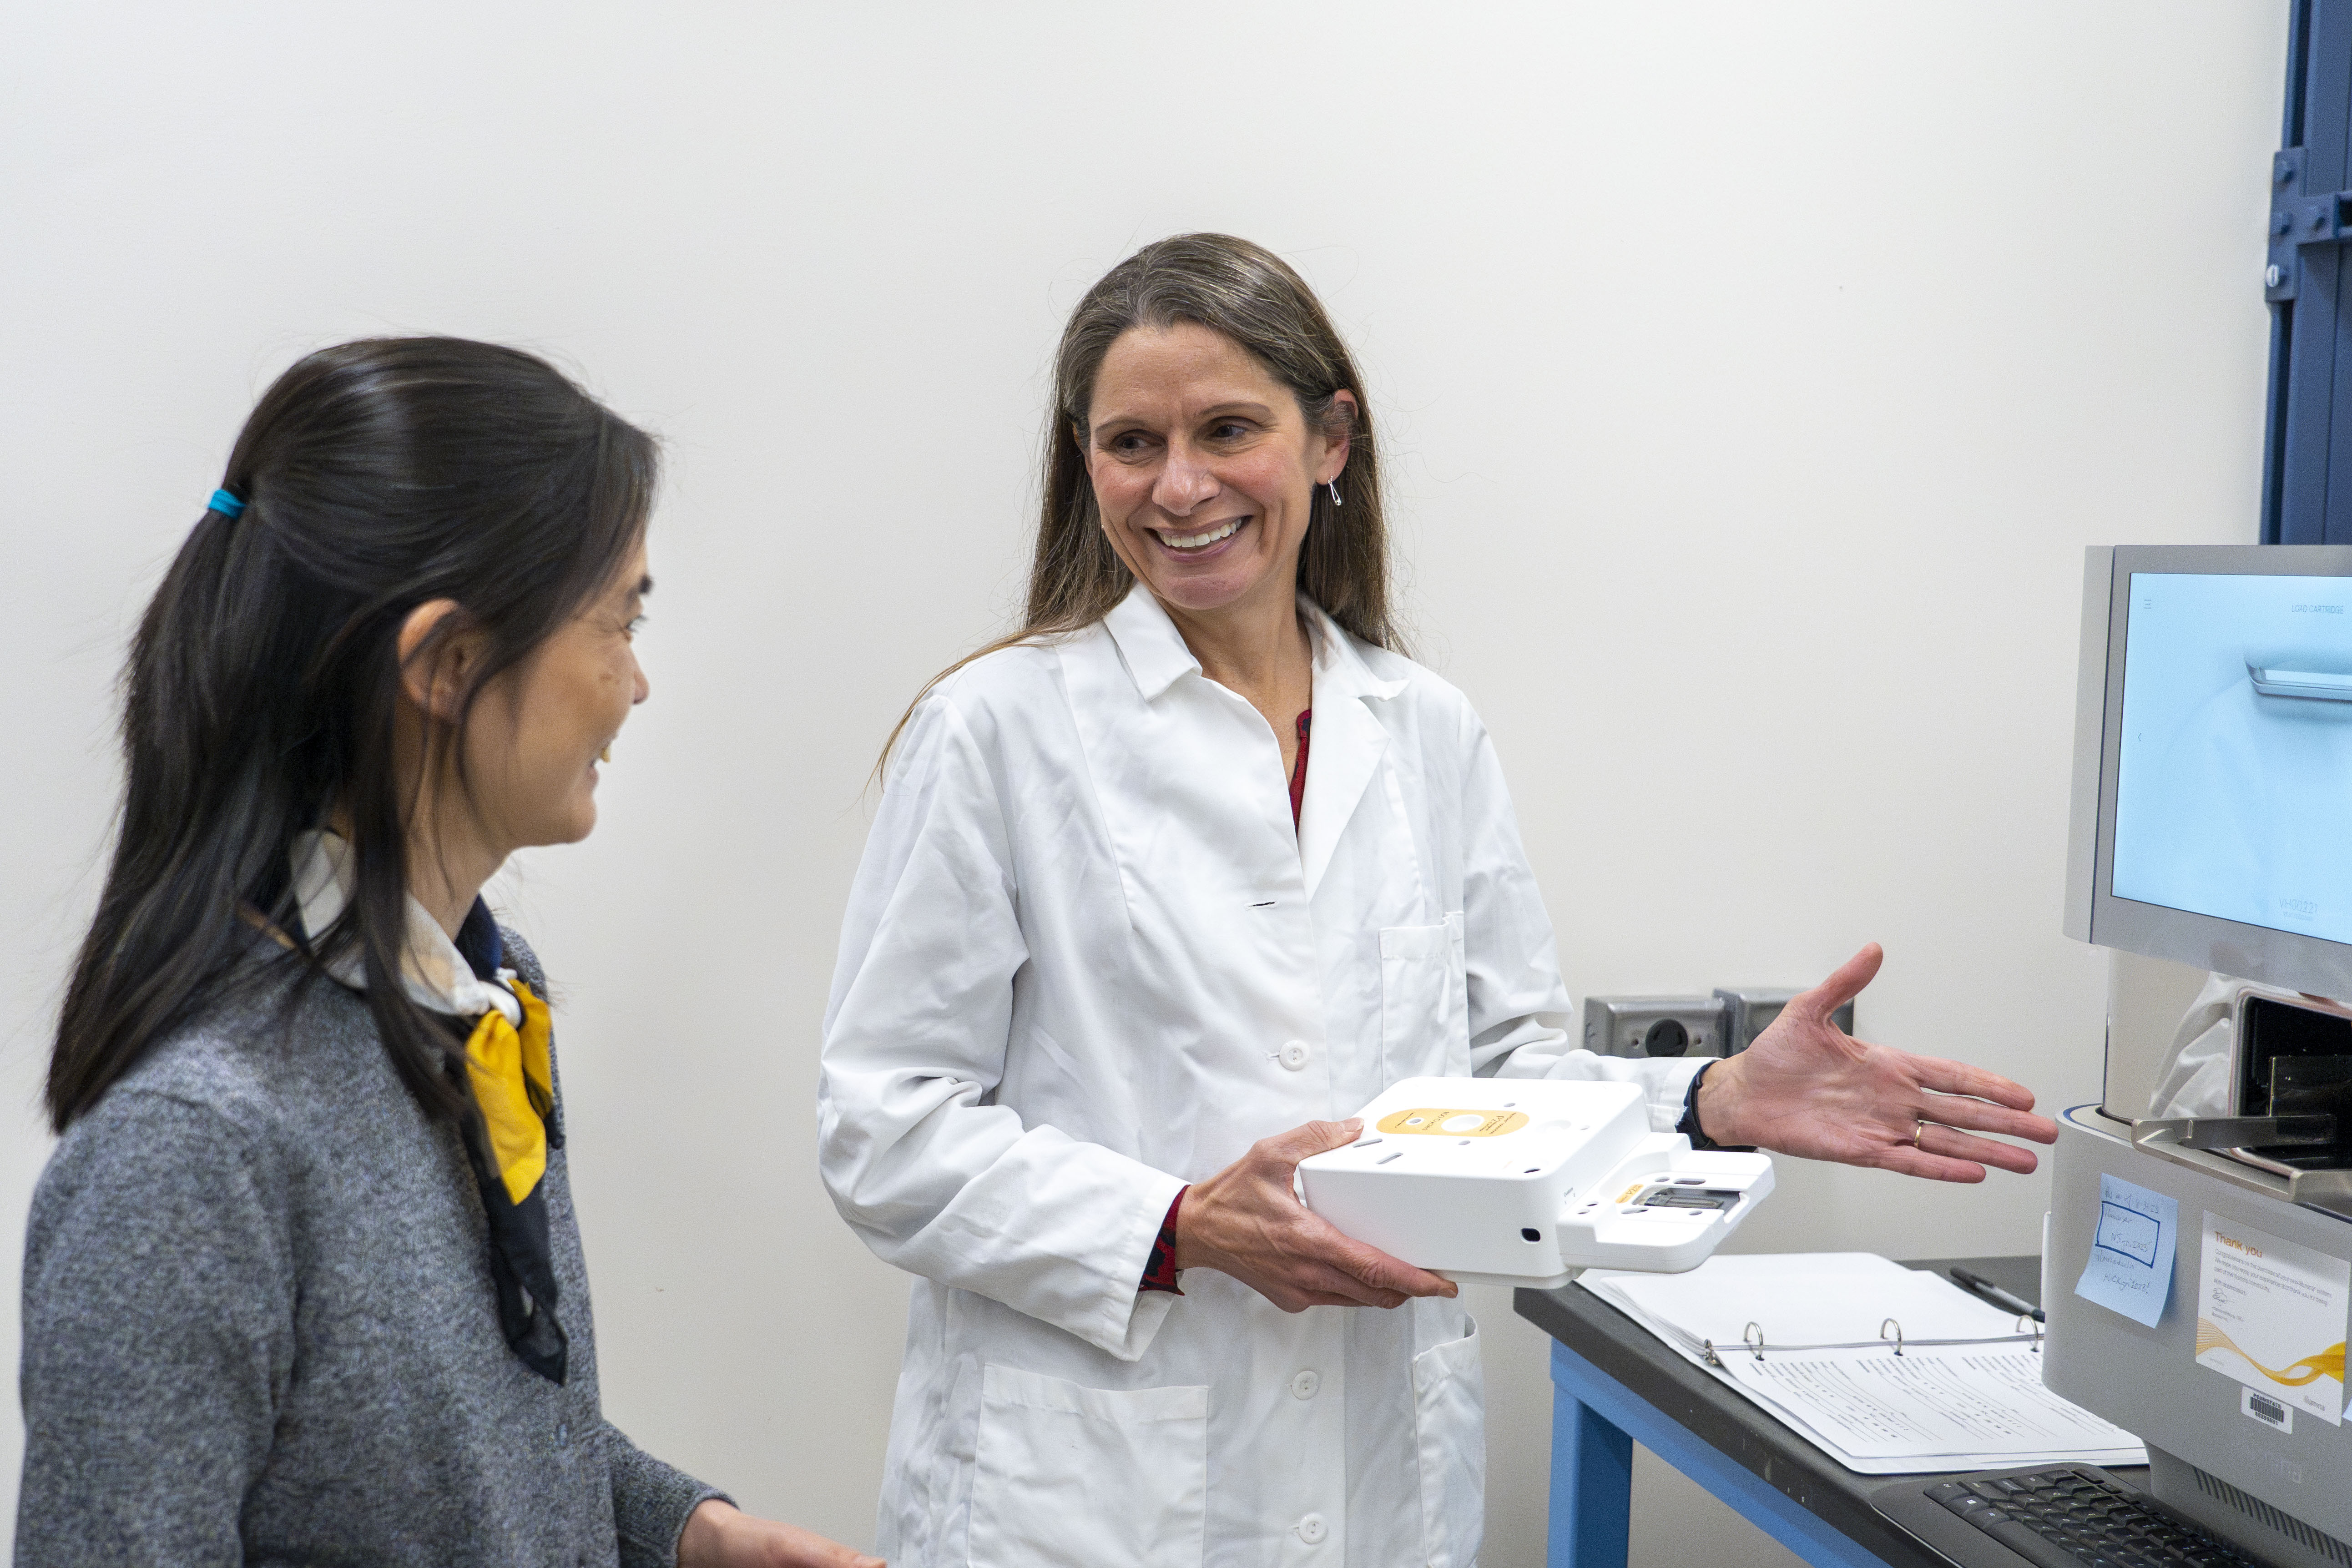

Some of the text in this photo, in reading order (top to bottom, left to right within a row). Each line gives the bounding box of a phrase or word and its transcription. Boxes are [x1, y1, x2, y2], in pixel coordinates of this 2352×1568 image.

[2291, 605, 2344, 614] LOAD CARTRIDGE
[2215, 1231, 2262, 1258] Thank you
